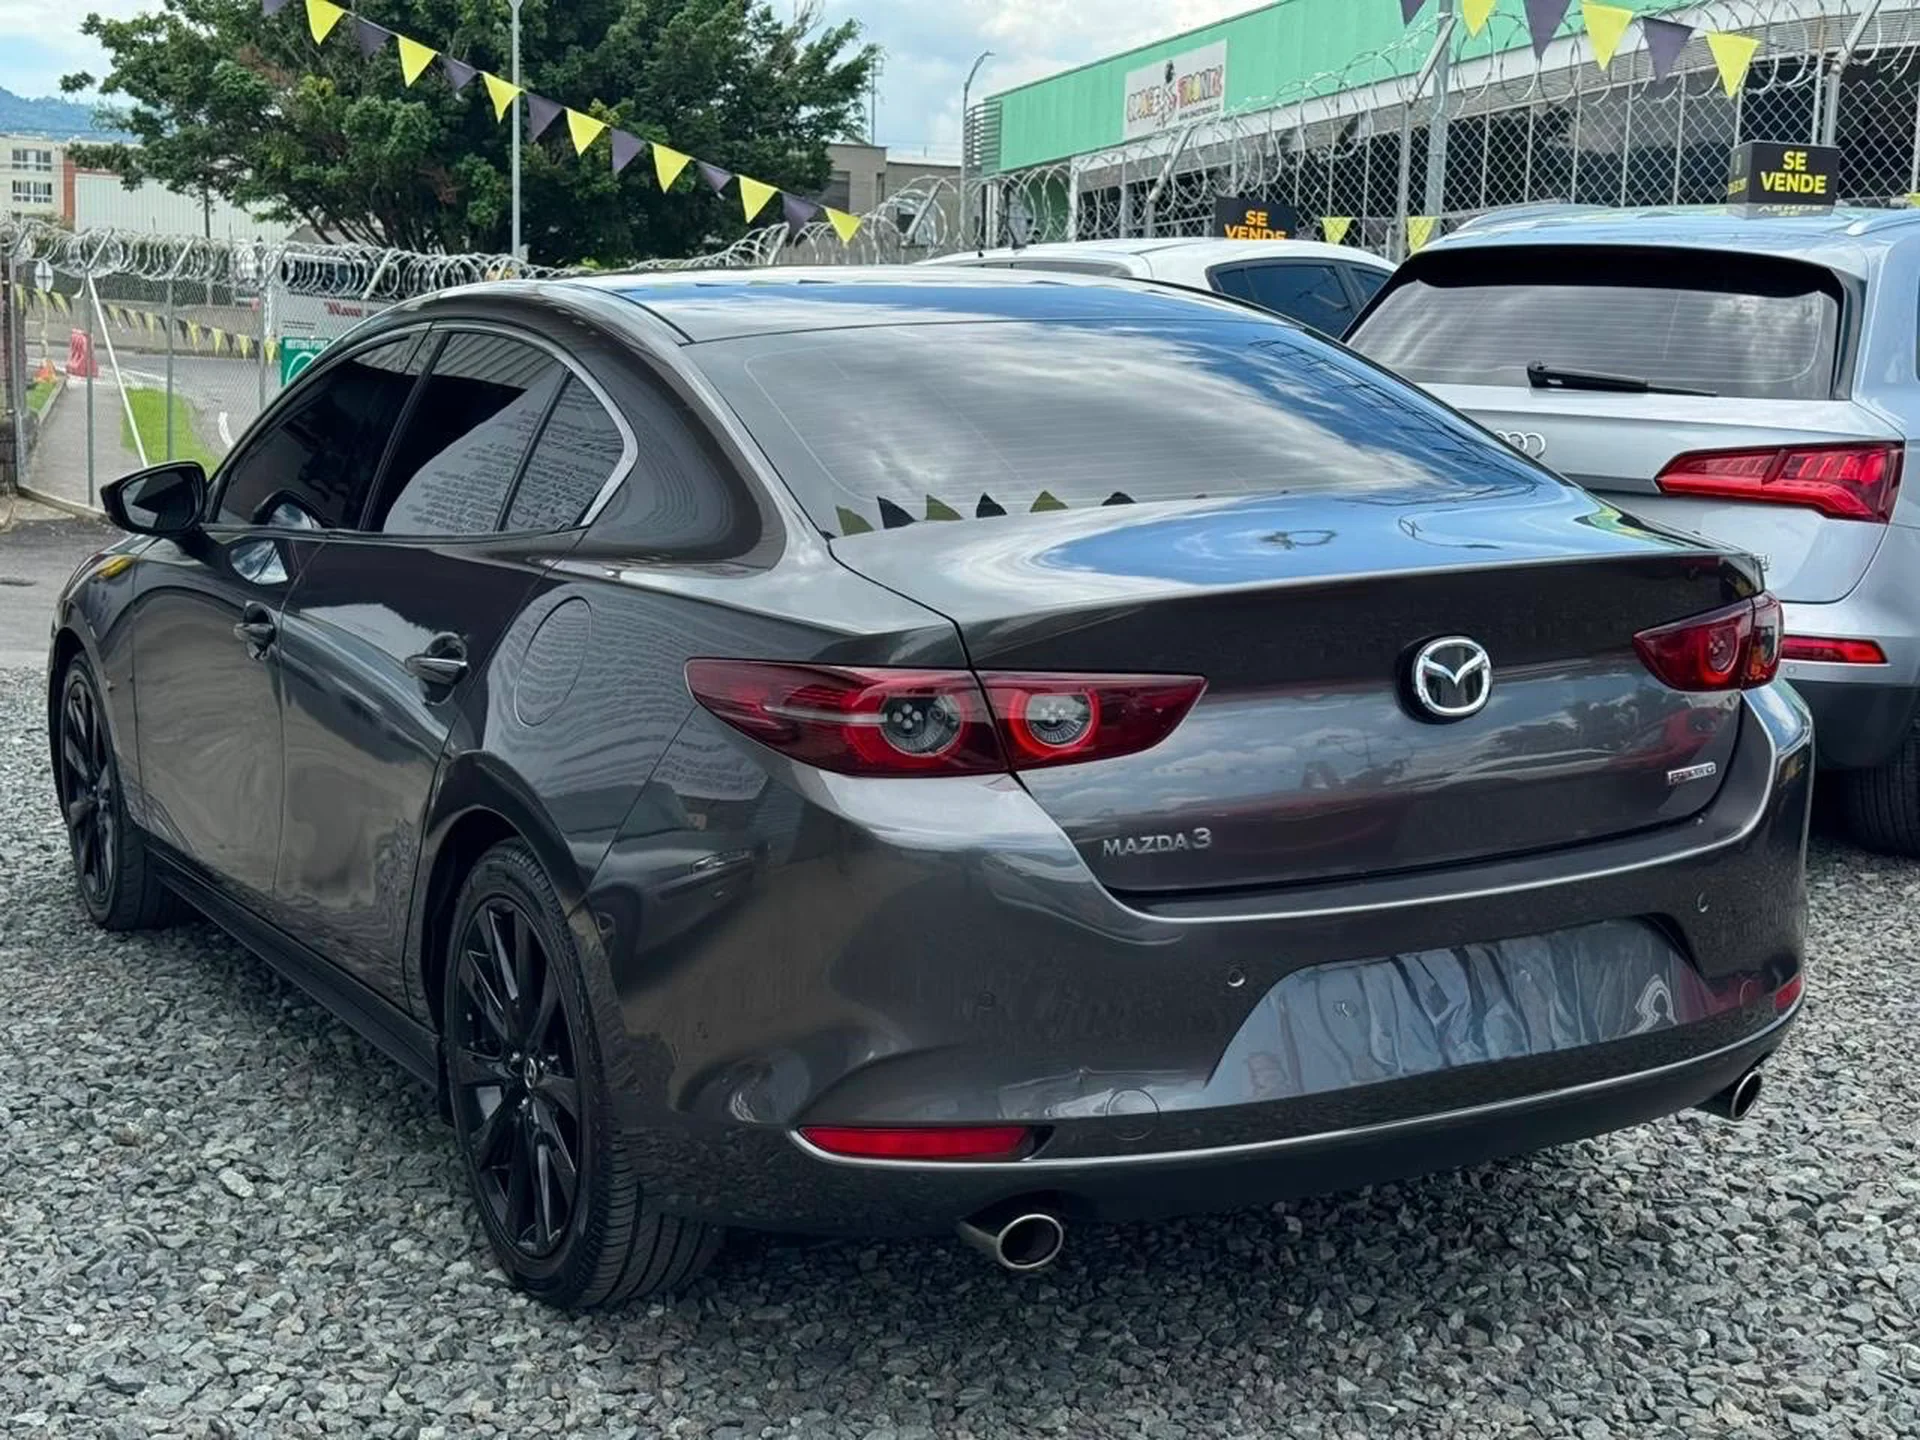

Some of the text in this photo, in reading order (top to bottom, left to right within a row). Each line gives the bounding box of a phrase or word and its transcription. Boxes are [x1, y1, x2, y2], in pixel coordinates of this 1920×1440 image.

[1783, 151, 1807, 171] SE
[1760, 171, 1827, 194] VENDE
[1245, 210, 1268, 227] SE
[1224, 224, 1287, 240] VENDE
